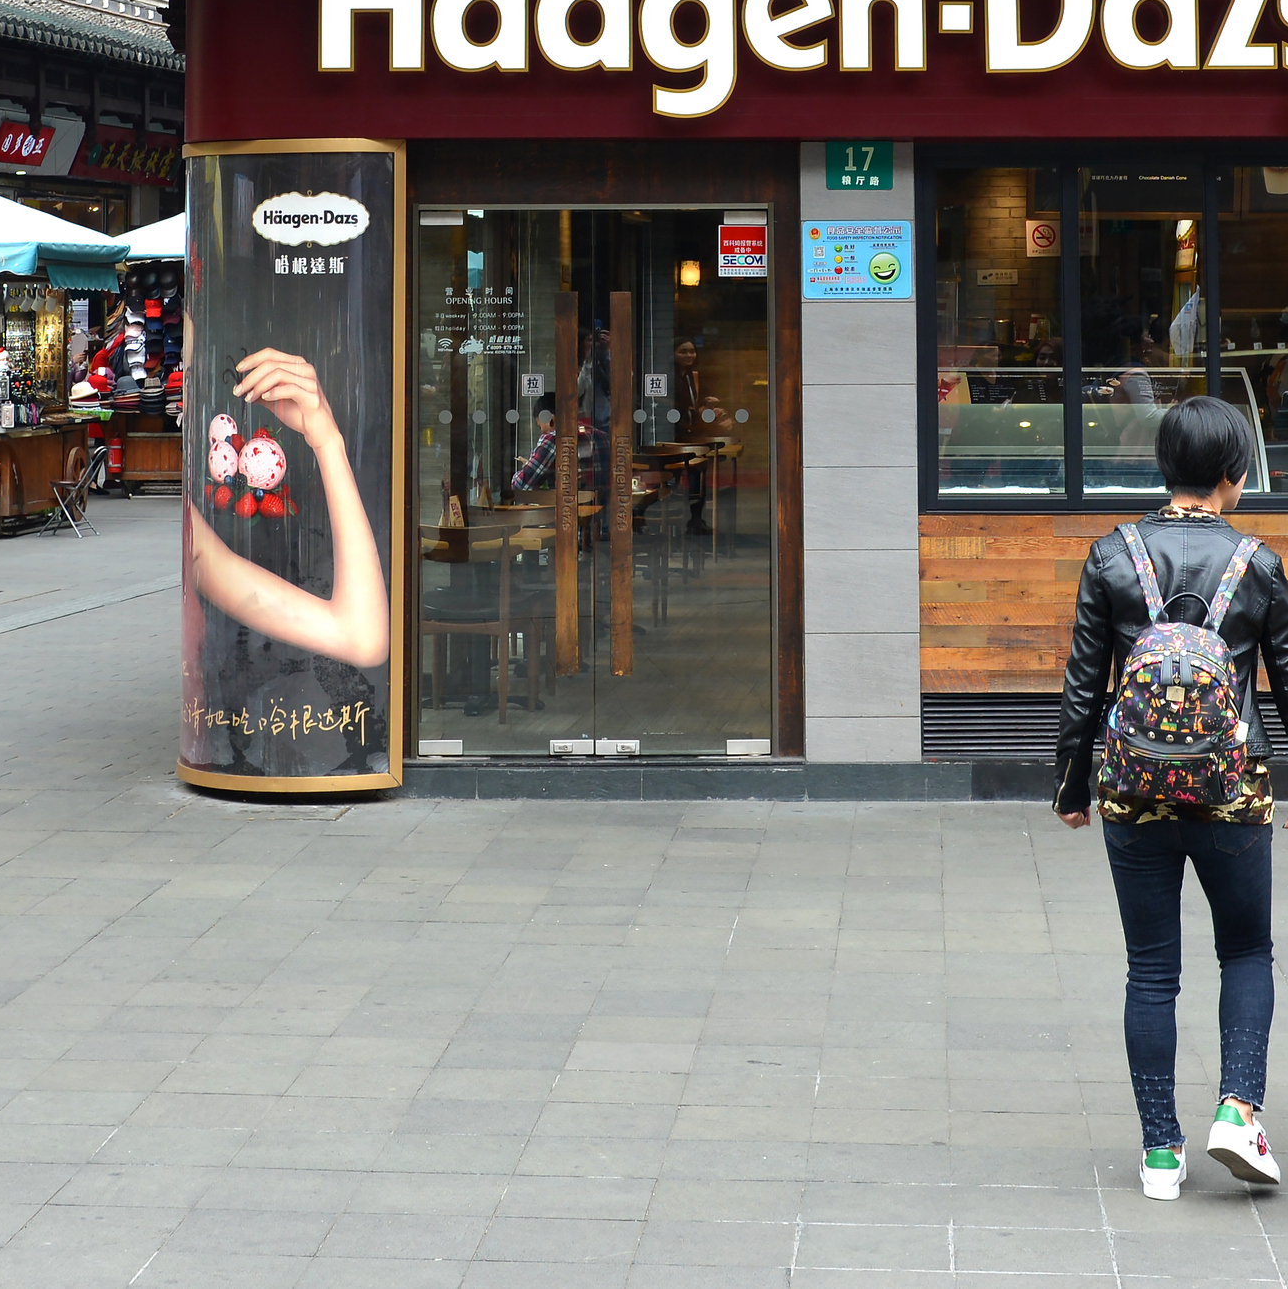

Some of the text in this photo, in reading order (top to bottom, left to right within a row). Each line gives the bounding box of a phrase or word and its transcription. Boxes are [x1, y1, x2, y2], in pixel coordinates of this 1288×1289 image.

[845, 147, 874, 171] 17
[842, 175, 879, 186] 粮厅路
[275, 254, 345, 275] 哈根達斯
[723, 255, 763, 265] SECOM
[445, 297, 513, 305] OPENING HOURS
[527, 377, 539, 389] 拉
[650, 377, 662, 389] 拉
